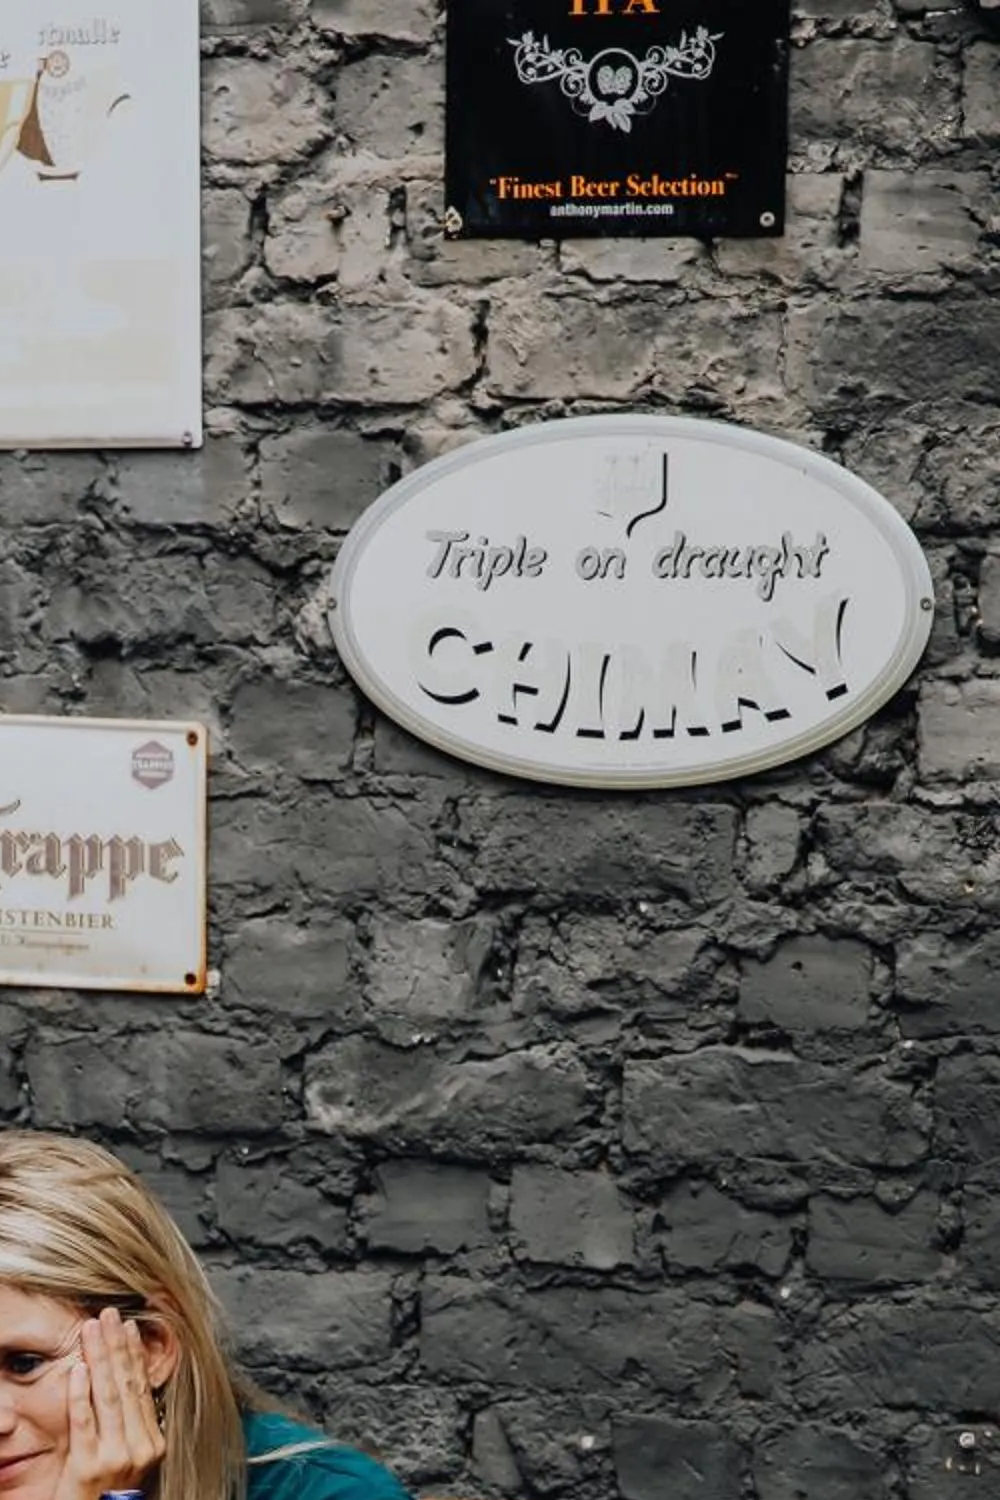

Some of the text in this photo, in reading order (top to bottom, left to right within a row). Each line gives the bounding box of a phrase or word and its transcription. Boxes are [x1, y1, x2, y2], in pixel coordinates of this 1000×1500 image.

[571, 175, 620, 198] Beer
[550, 202, 674, 218] anthonymartin.com
[425, 529, 831, 602] Triple on draught
